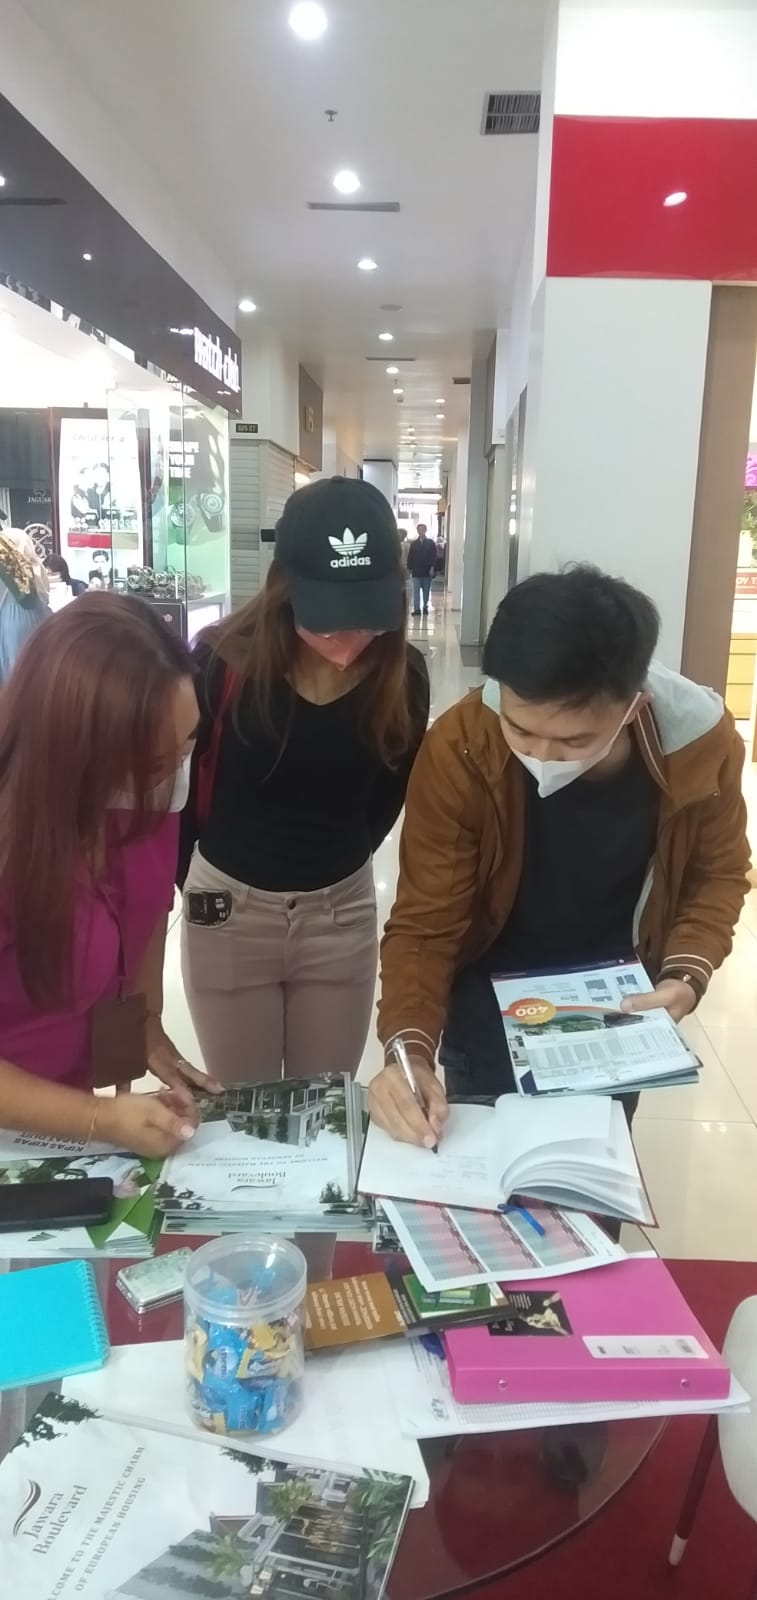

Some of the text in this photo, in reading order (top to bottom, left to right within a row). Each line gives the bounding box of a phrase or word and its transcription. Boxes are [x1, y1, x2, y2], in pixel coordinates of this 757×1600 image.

[330, 555, 371, 568] adidas
[515, 1006, 548, 1017] 400
[14, 1138, 84, 1152] KIPAS KIPAS
[23, 1492, 64, 1539] Jawara
[32, 1484, 87, 1554] Boulevard
[48, 1446, 145, 1600] COME TO THE MAJESTIC CHARM
[75, 1476, 146, 1591] OF EUROPEAN HOUSING
